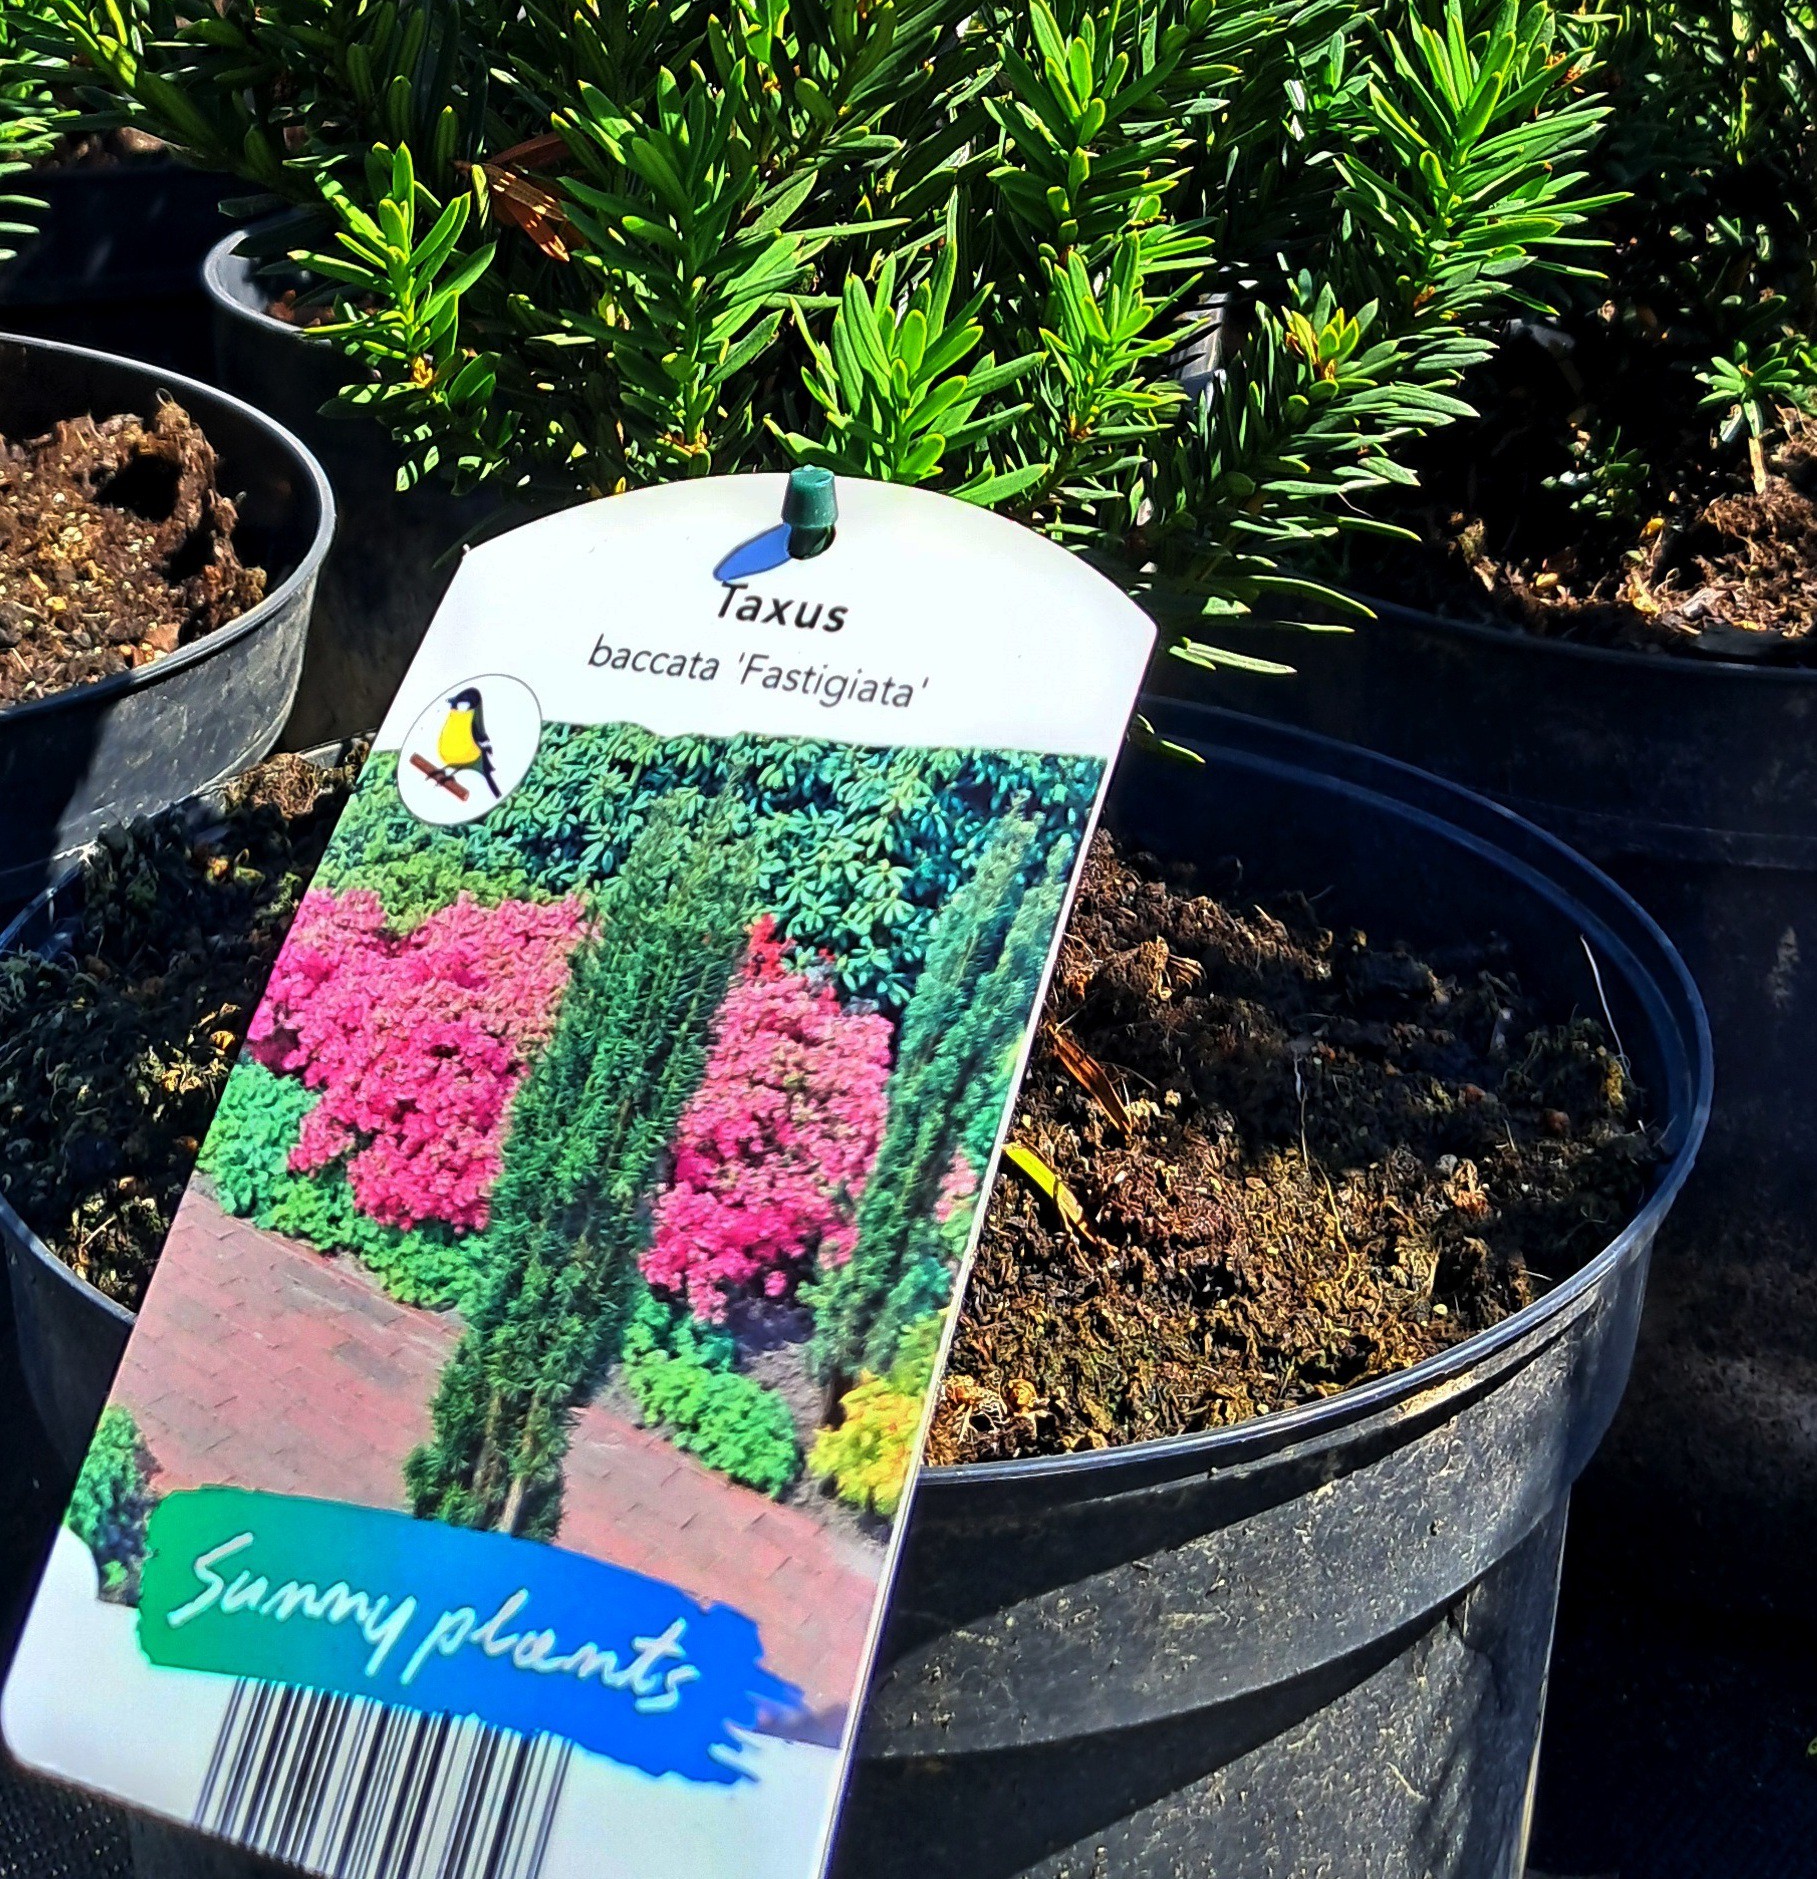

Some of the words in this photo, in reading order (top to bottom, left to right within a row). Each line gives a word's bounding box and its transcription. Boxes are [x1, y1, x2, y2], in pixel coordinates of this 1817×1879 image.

[716, 581, 848, 633] Taxus
[587, 633, 720, 681] baccata
[736, 651, 929, 708] 'Fastigiata'
